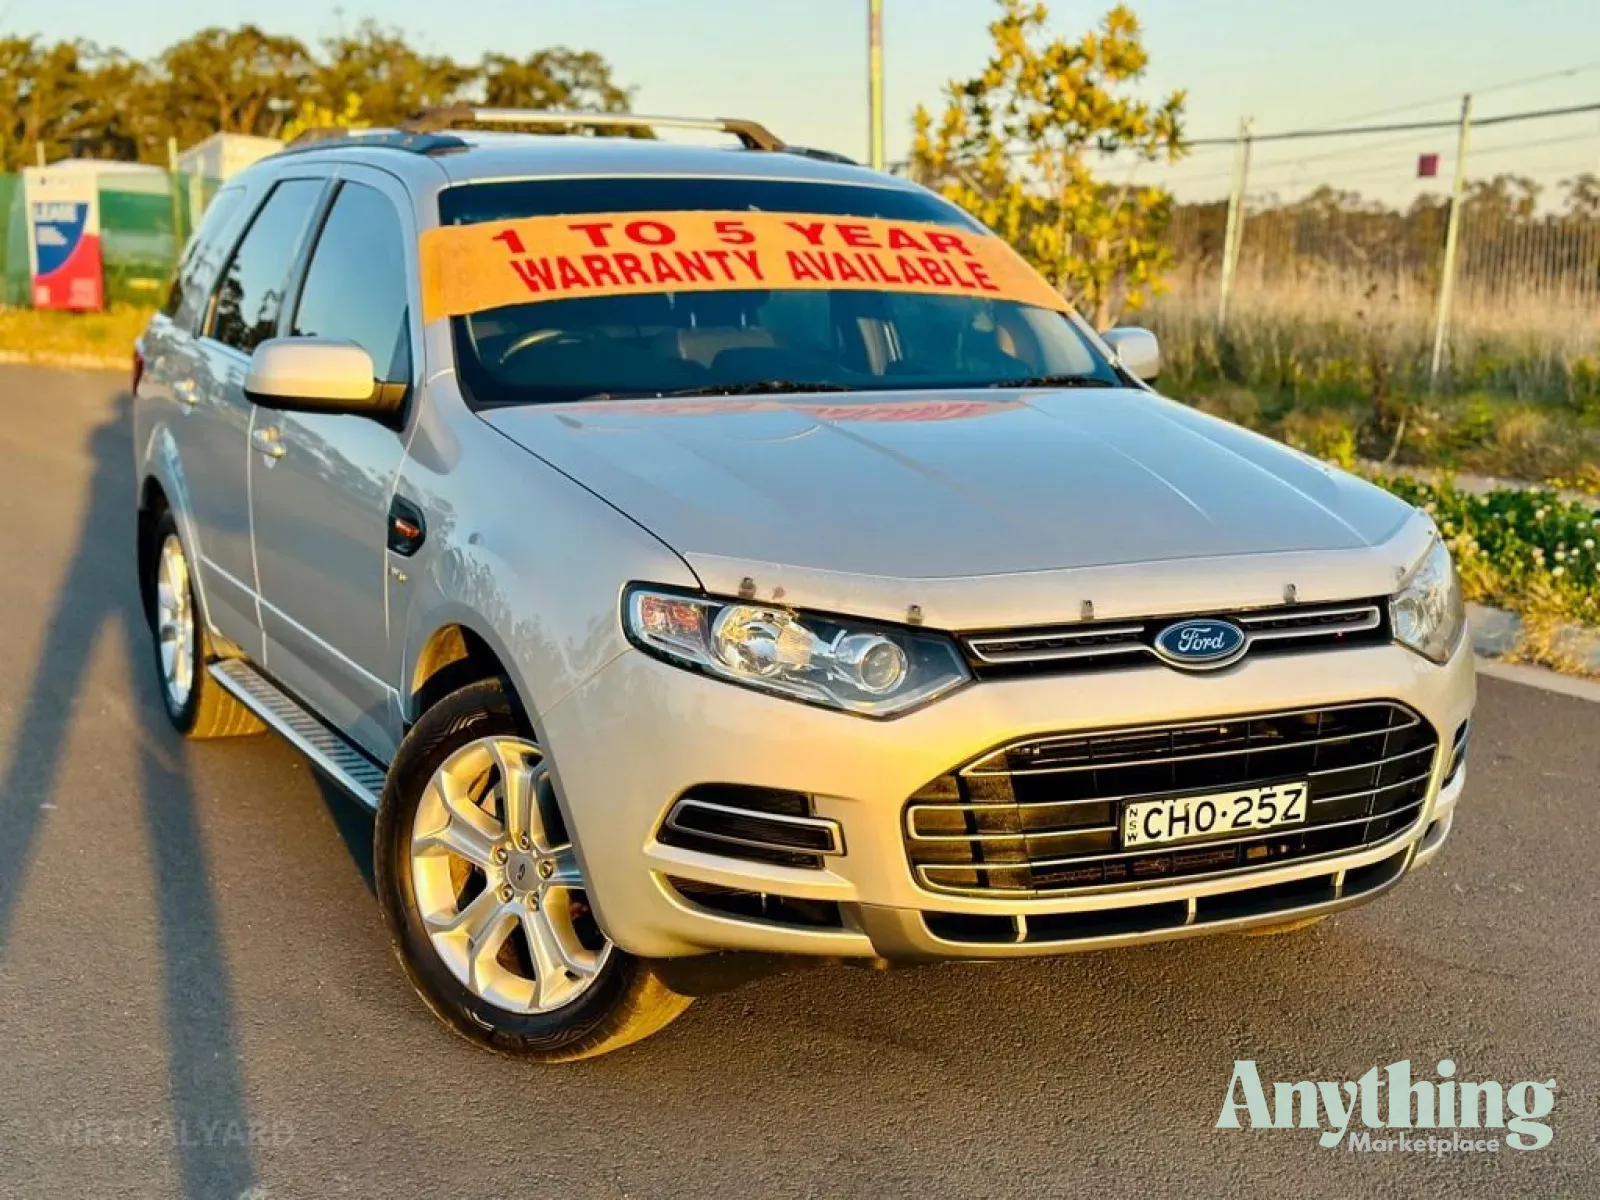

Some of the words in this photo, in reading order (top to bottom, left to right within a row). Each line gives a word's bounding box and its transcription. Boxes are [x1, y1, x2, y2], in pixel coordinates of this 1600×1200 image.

[492, 228, 526, 254] 1
[568, 220, 677, 248] TO
[714, 221, 756, 245] 5
[784, 221, 975, 257] YEAR
[509, 250, 765, 293] WARRANTY
[786, 250, 1001, 292] AVAILABLE
[1177, 627, 1226, 652] Ford
[1127, 807, 1138, 843] NSW
